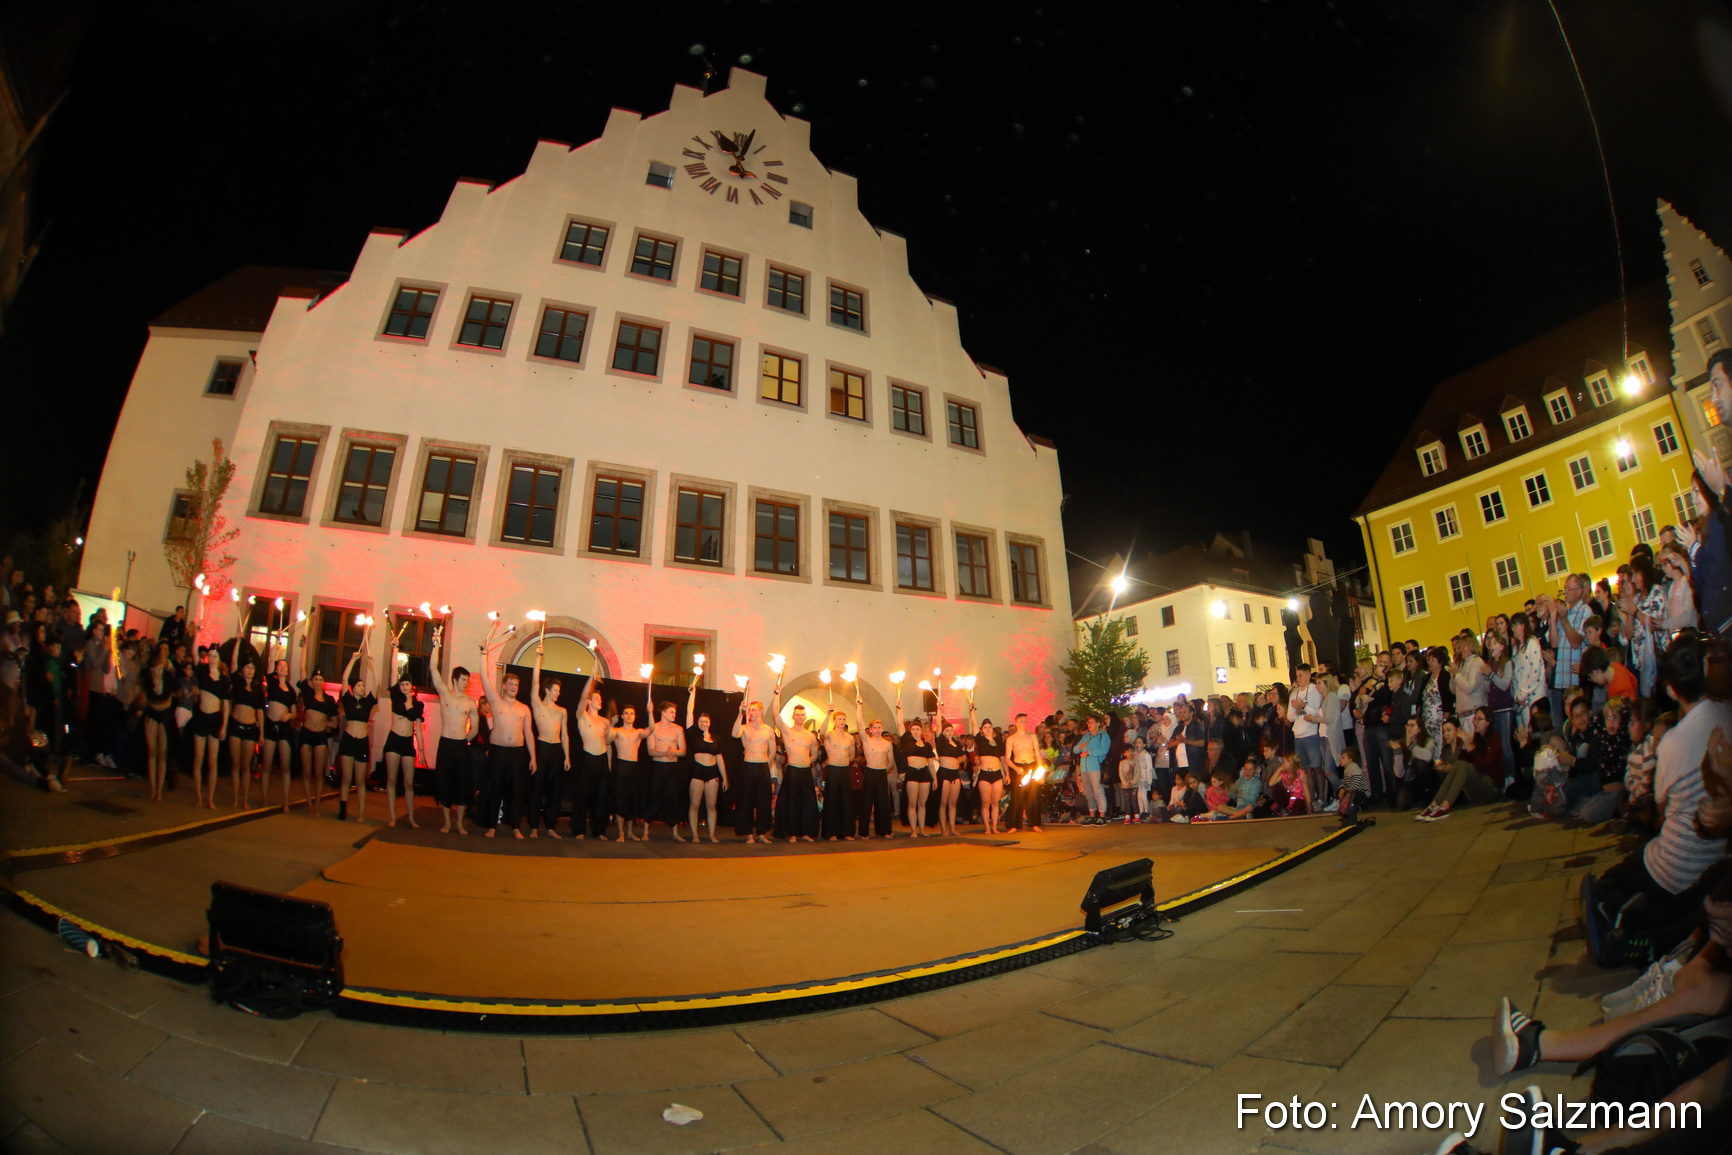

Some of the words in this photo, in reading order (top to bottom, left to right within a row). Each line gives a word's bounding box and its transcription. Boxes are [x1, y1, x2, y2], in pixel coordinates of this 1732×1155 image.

[692, 135, 713, 150] X
[753, 144, 766, 154] I
[682, 147, 706, 160] IX
[684, 162, 710, 179] VIII
[767, 172, 788, 185] III
[699, 176, 722, 194] VII
[760, 182, 783, 200] IV
[726, 186, 738, 204] VI
[749, 188, 763, 205] V
